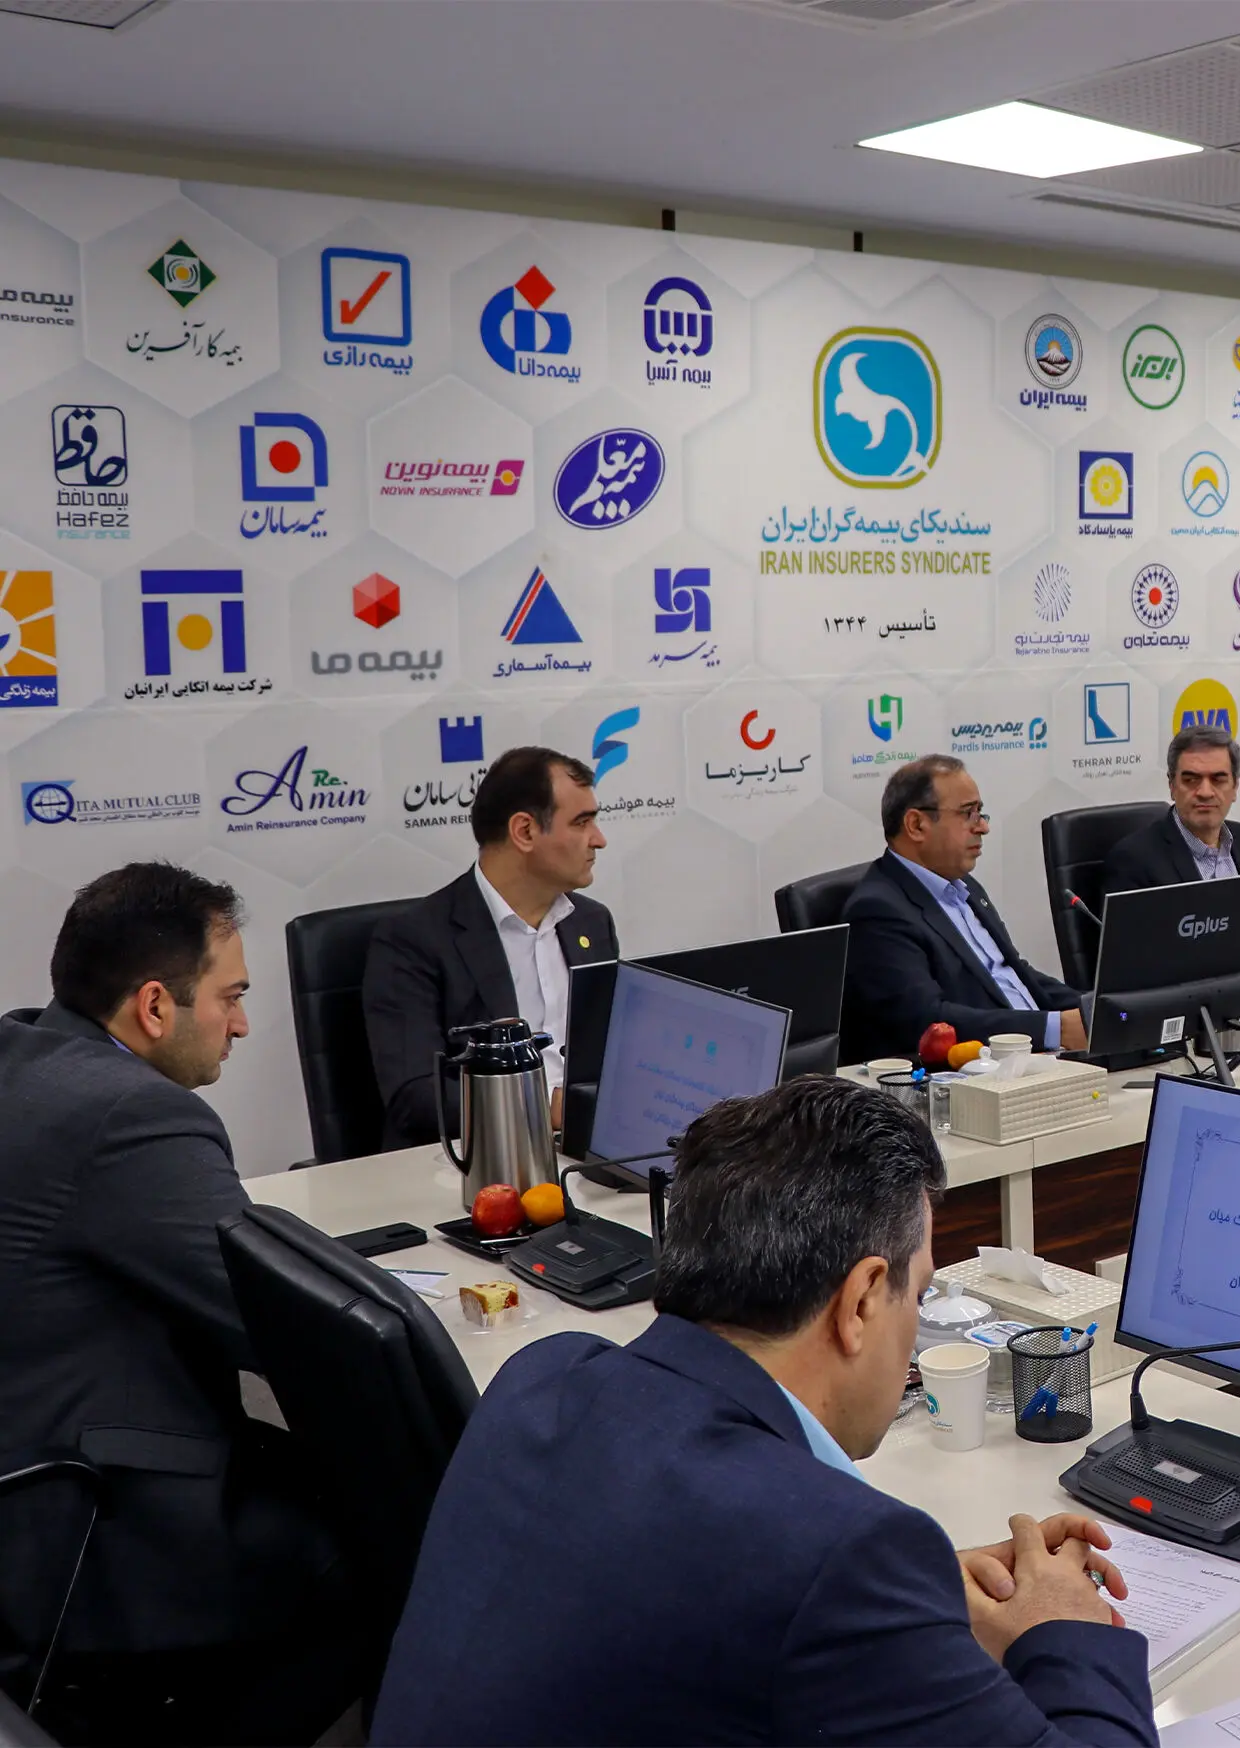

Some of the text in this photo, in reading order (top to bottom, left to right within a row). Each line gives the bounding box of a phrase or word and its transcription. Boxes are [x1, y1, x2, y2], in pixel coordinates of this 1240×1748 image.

[21, 291, 74, 313] بیمه
[0, 313, 75, 326] nsurance
[218, 343, 243, 366] بیمه
[323, 345, 414, 375] بیمه رازی
[518, 357, 582, 384] بیمه دانا
[646, 360, 712, 389] بیمه آسیا
[1019, 388, 1087, 411] بیمه ایران
[385, 458, 490, 483] بیمه نوین
[56, 488, 129, 511] بیمه حافظ
[56, 511, 129, 527] Hafez
[240, 505, 328, 539] بیمه سامان
[761, 505, 815, 543] ایران
[900, 508, 991, 544] سندیکای
[1079, 524, 1133, 539] بیمه پاسارگاد
[760, 551, 992, 575] IRAN INSURERS SYNDICATE
[823, 608, 937, 639] تأسیس ۱۳۴۴
[1066, 633, 1090, 646] بیمه
[1124, 631, 1190, 650] بیمه تعاون
[310, 647, 443, 680] بیمه ما
[492, 652, 593, 677] بیمه آسماری
[700, 643, 722, 667] بیمه
[124, 682, 169, 699] ایرانیان
[212, 682, 235, 695] بیمه
[238, 678, 273, 695] شرکت
[952, 722, 1024, 738] بیمه پردیس
[951, 740, 1025, 753] Pardis Insurance
[705, 754, 812, 785] کاریزما
[1072, 754, 1141, 768] TEHRAN RUCK
[103, 796, 163, 810] MUTUAL
[164, 793, 200, 806] CLUB
[403, 780, 458, 813] سامان
[597, 797, 676, 813] بیمه هوشمن
[227, 813, 367, 834] Amin Reinsurance Company
[404, 815, 448, 829] SAMAN
[1178, 913, 1229, 939] Gplus
[1208, 1208, 1230, 1224] میان
